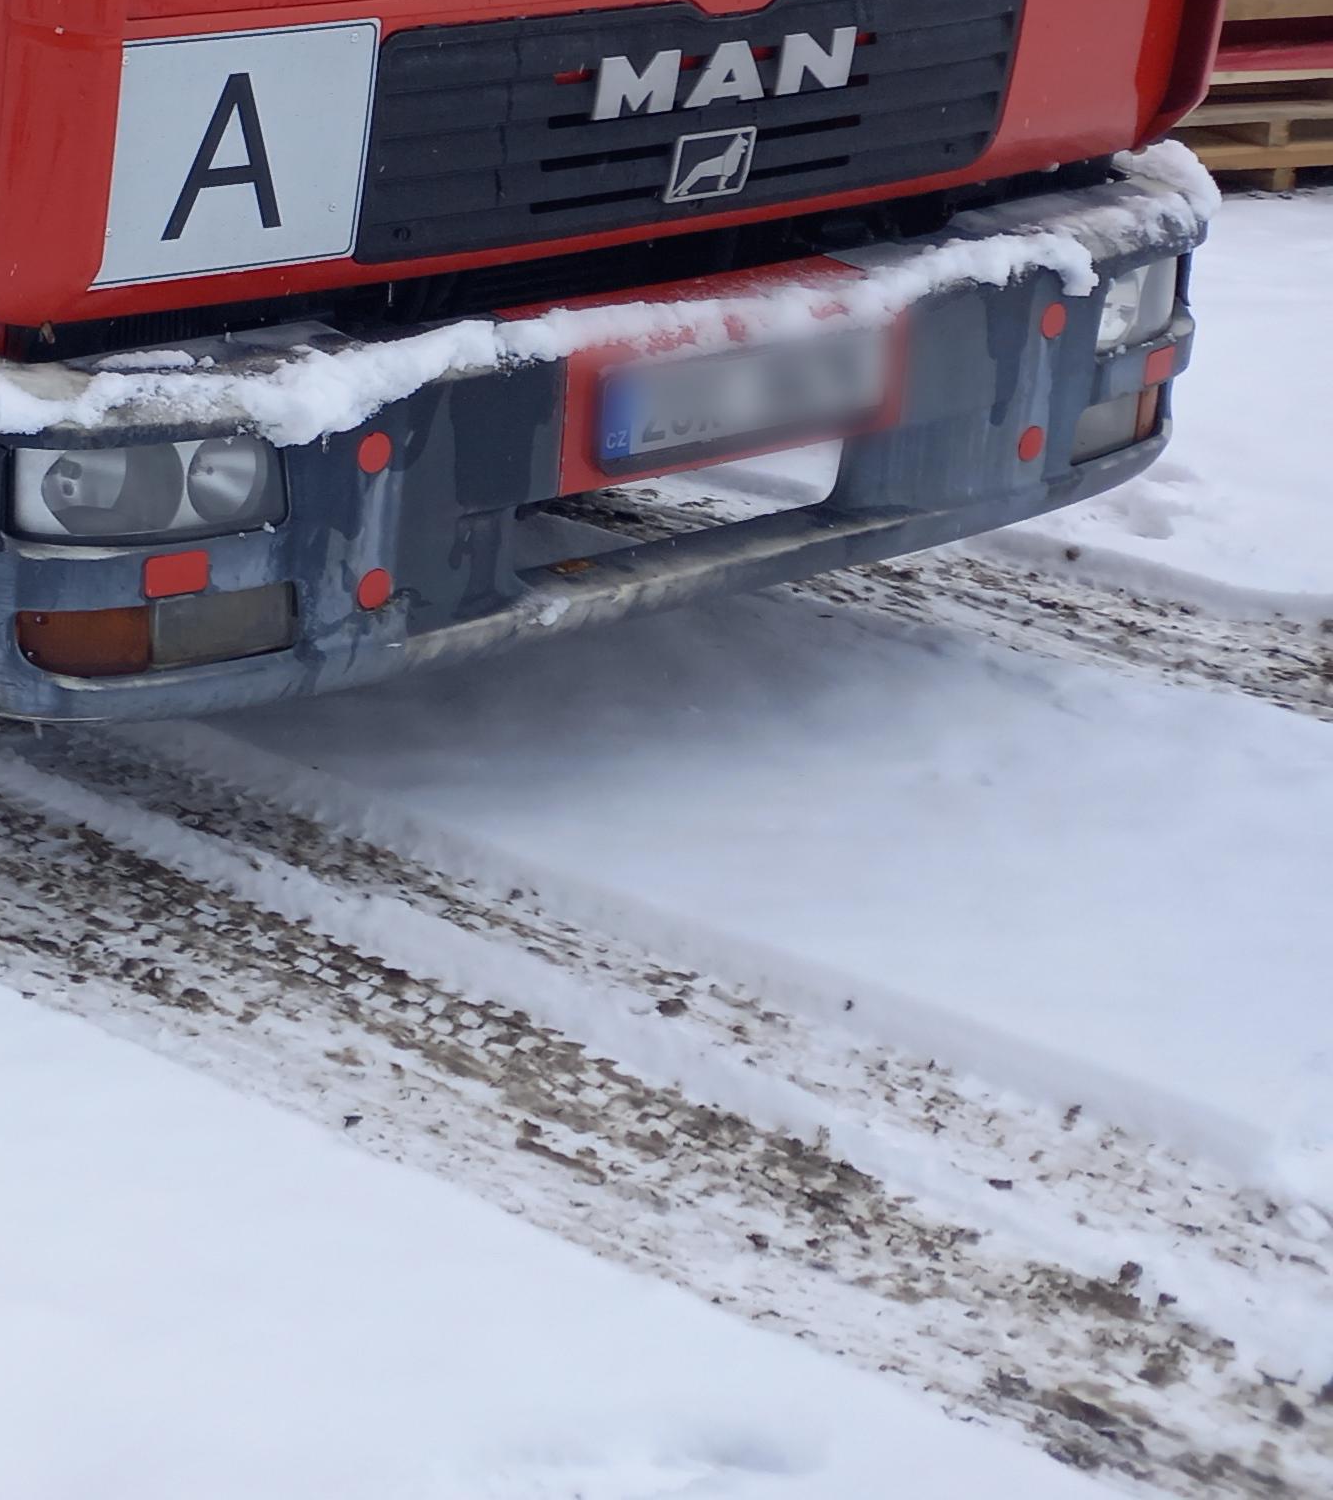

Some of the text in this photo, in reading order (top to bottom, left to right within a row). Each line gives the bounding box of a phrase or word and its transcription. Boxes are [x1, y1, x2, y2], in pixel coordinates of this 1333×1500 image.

[591, 26, 859, 121] MAN
[161, 72, 283, 242] A
[605, 429, 628, 450] CZ
